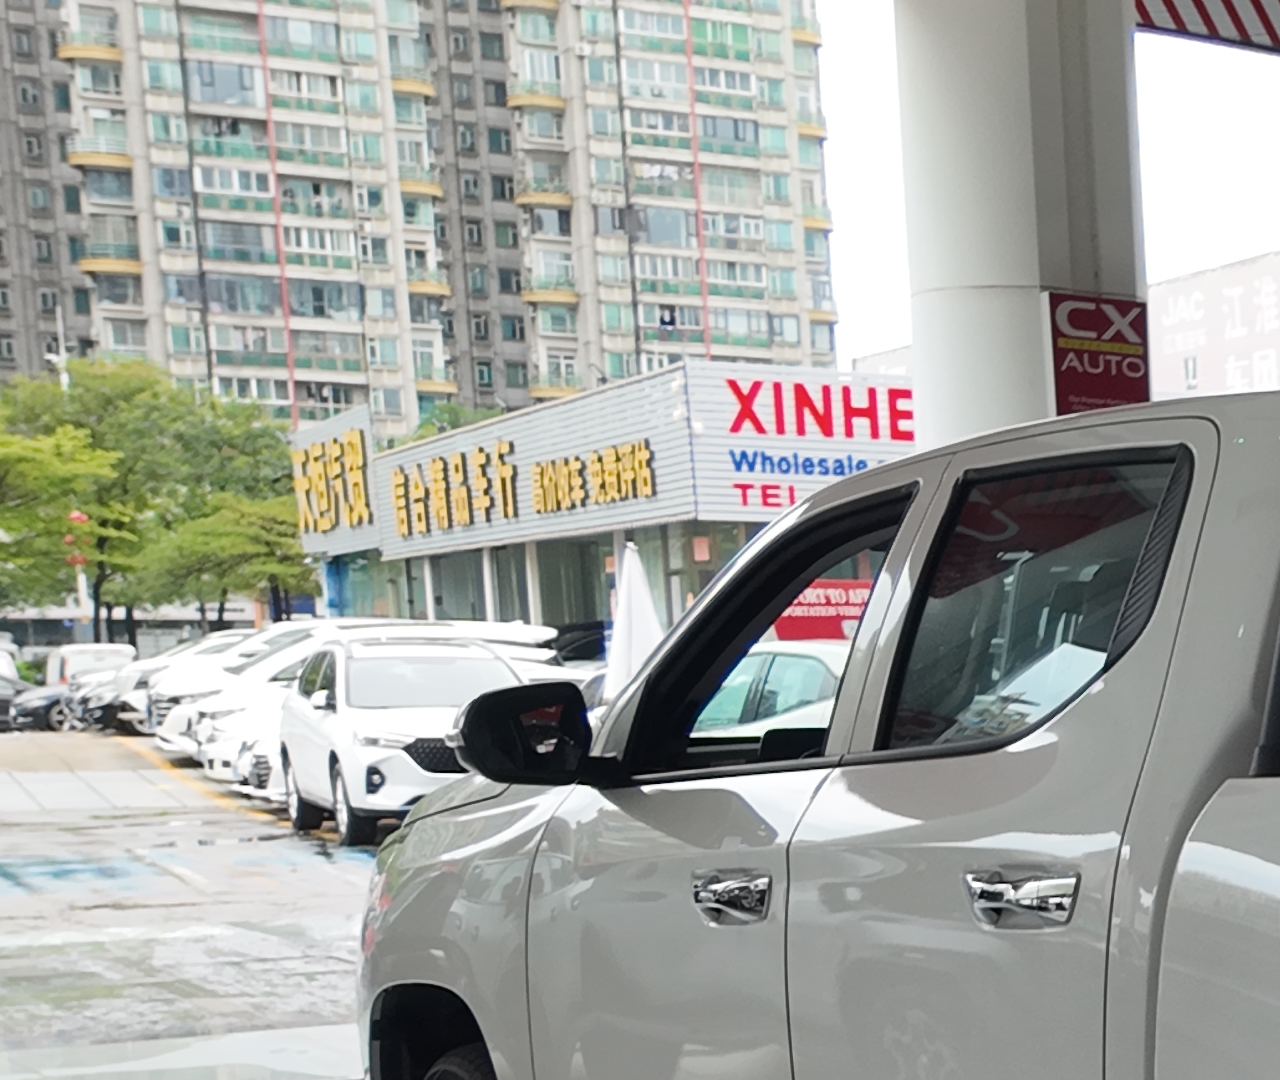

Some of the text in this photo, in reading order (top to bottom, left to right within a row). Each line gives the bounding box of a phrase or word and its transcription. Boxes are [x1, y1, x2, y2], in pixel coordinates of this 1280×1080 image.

[1055, 300, 1143, 344] CX
[1161, 291, 1205, 327] JAC
[1060, 351, 1145, 378] AUTO
[726, 378, 915, 442] XINHE
[728, 449, 869, 477] Wholesale
